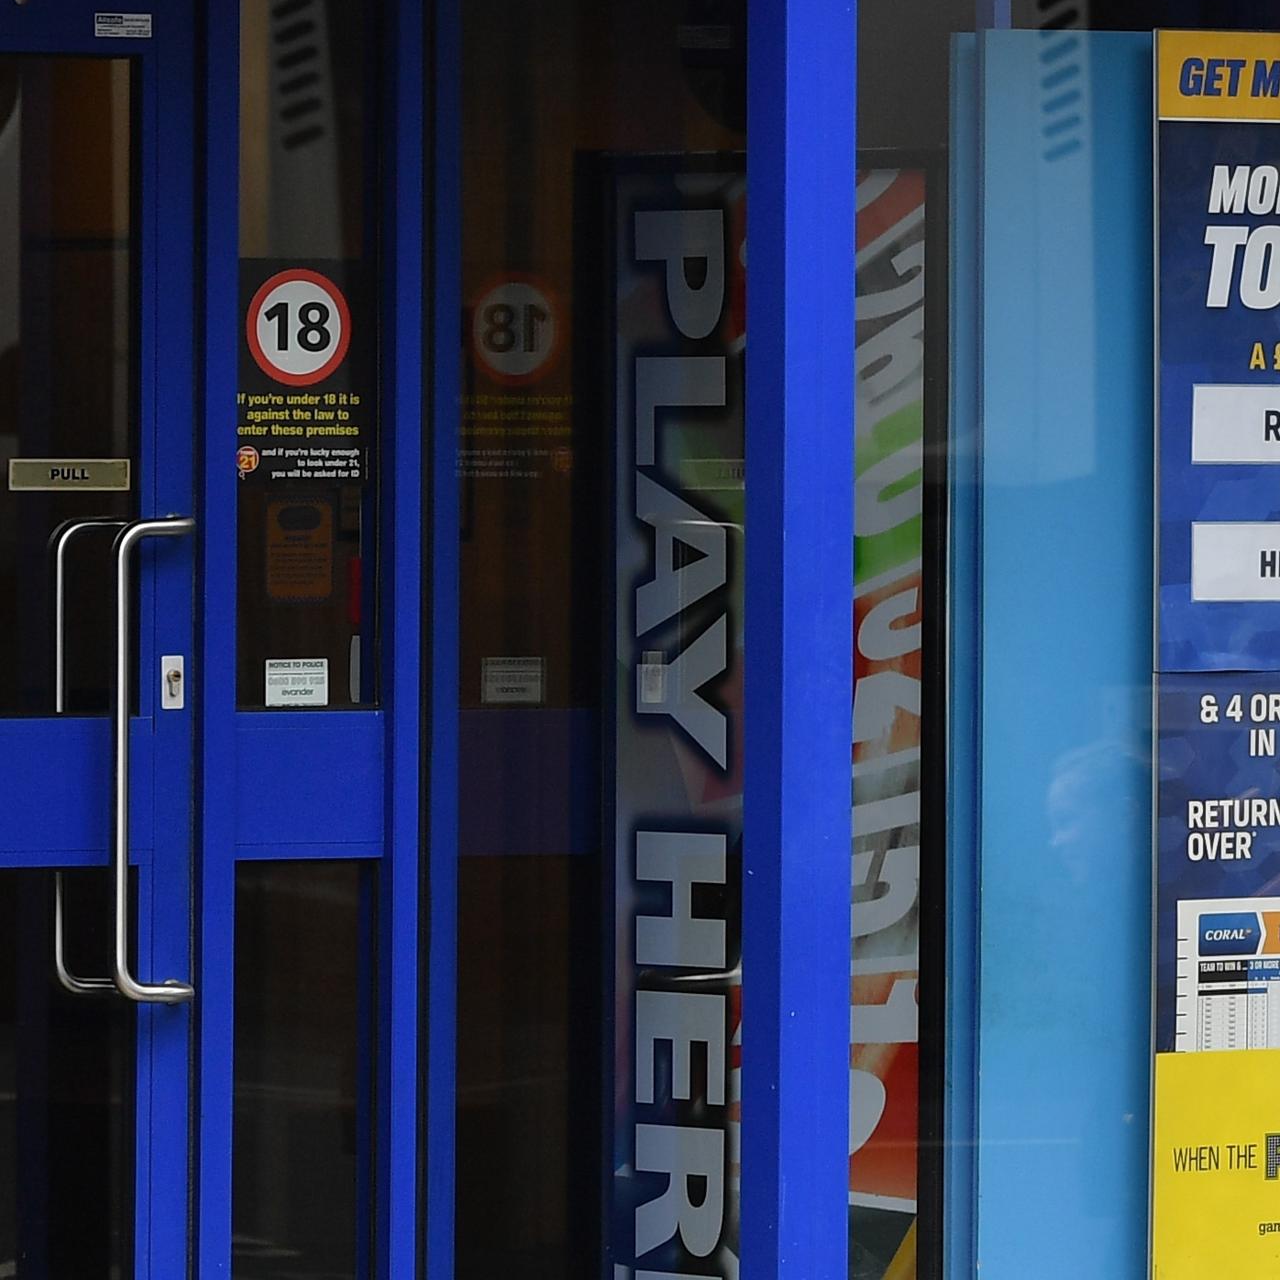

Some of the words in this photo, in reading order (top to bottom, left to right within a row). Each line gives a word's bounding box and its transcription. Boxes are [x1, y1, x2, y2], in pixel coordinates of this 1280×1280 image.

[1179, 58, 1245, 98] GET
[264, 302, 331, 352] 18
[1249, 343, 1267, 371] A
[237, 394, 245, 404] If
[248, 394, 283, 407] you're
[287, 394, 320, 404] under
[323, 394, 336, 404] 18
[339, 394, 347, 404] it
[350, 394, 360, 404] is
[247, 409, 289, 422] against
[292, 409, 311, 420] the
[314, 409, 334, 420] law
[337, 410, 349, 420] to
[237, 425, 268, 435] enter
[271, 424, 303, 435] these
[306, 424, 359, 437] premises
[50, 469, 89, 480] PULL
[634, 209, 727, 770] PLAY
[281, 687, 313, 696] evander
[1200, 695, 1219, 723] &
[1226, 695, 1243, 722] 4
[1250, 729, 1275, 756] IN
[1205, 929, 1245, 941] CORAL
[634, 831, 727, 1280] HER
[1174, 1146, 1219, 1171] WHEN
[1227, 1144, 1257, 1169] THE
